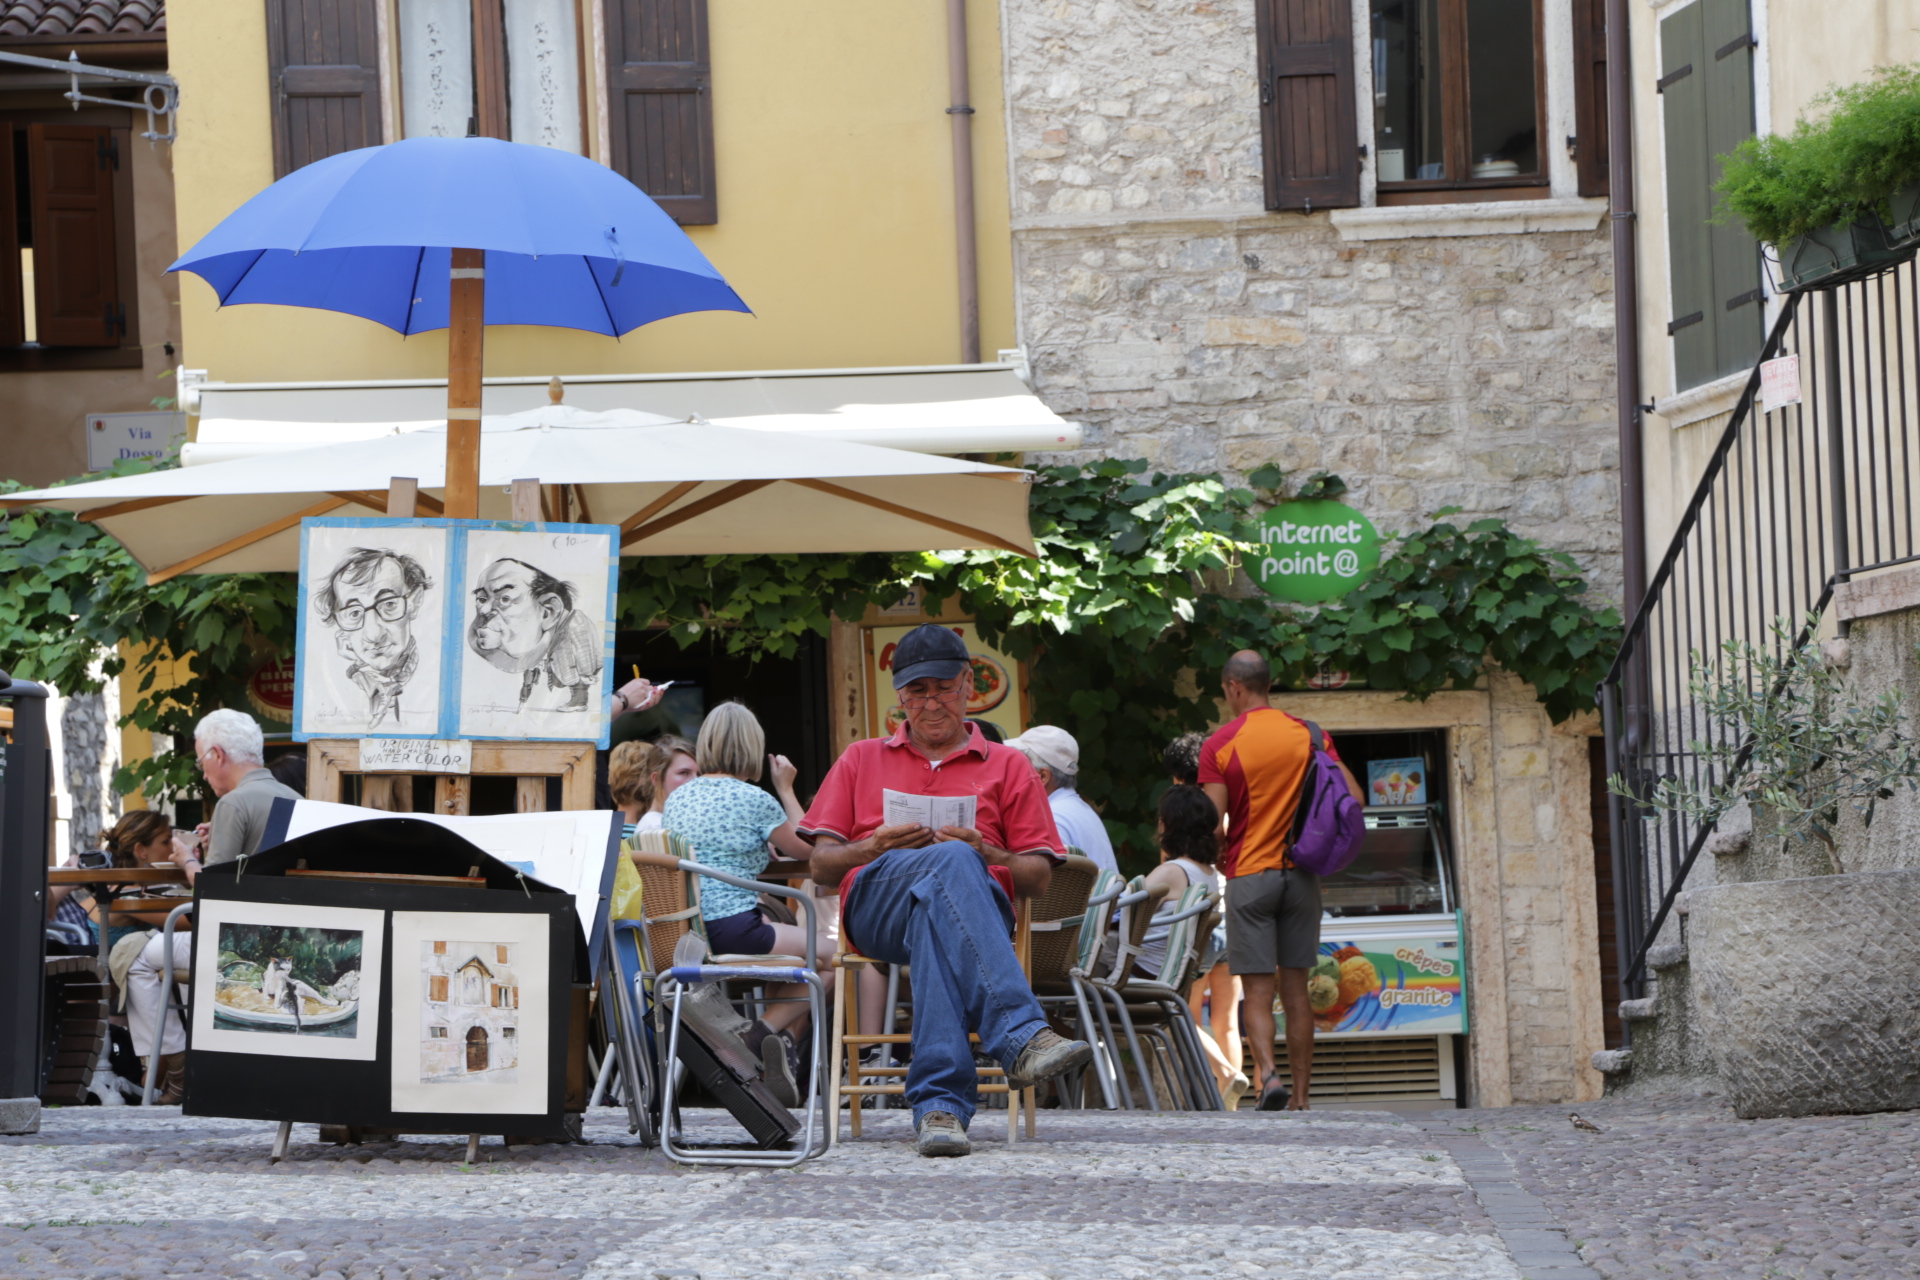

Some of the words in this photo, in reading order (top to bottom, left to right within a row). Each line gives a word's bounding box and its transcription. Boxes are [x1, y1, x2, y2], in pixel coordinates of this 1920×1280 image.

[128, 427, 152, 440] Via
[119, 448, 163, 460] Dosso
[1260, 520, 1363, 544] internet
[260, 671, 294, 681] BIR
[260, 682, 294, 693] PER
[379, 739, 439, 750] ORIGINAL
[363, 753, 410, 765] WATER
[415, 753, 462, 766] COLOR
[1395, 947, 1453, 975] crêpes
[1380, 987, 1452, 1008] granite
